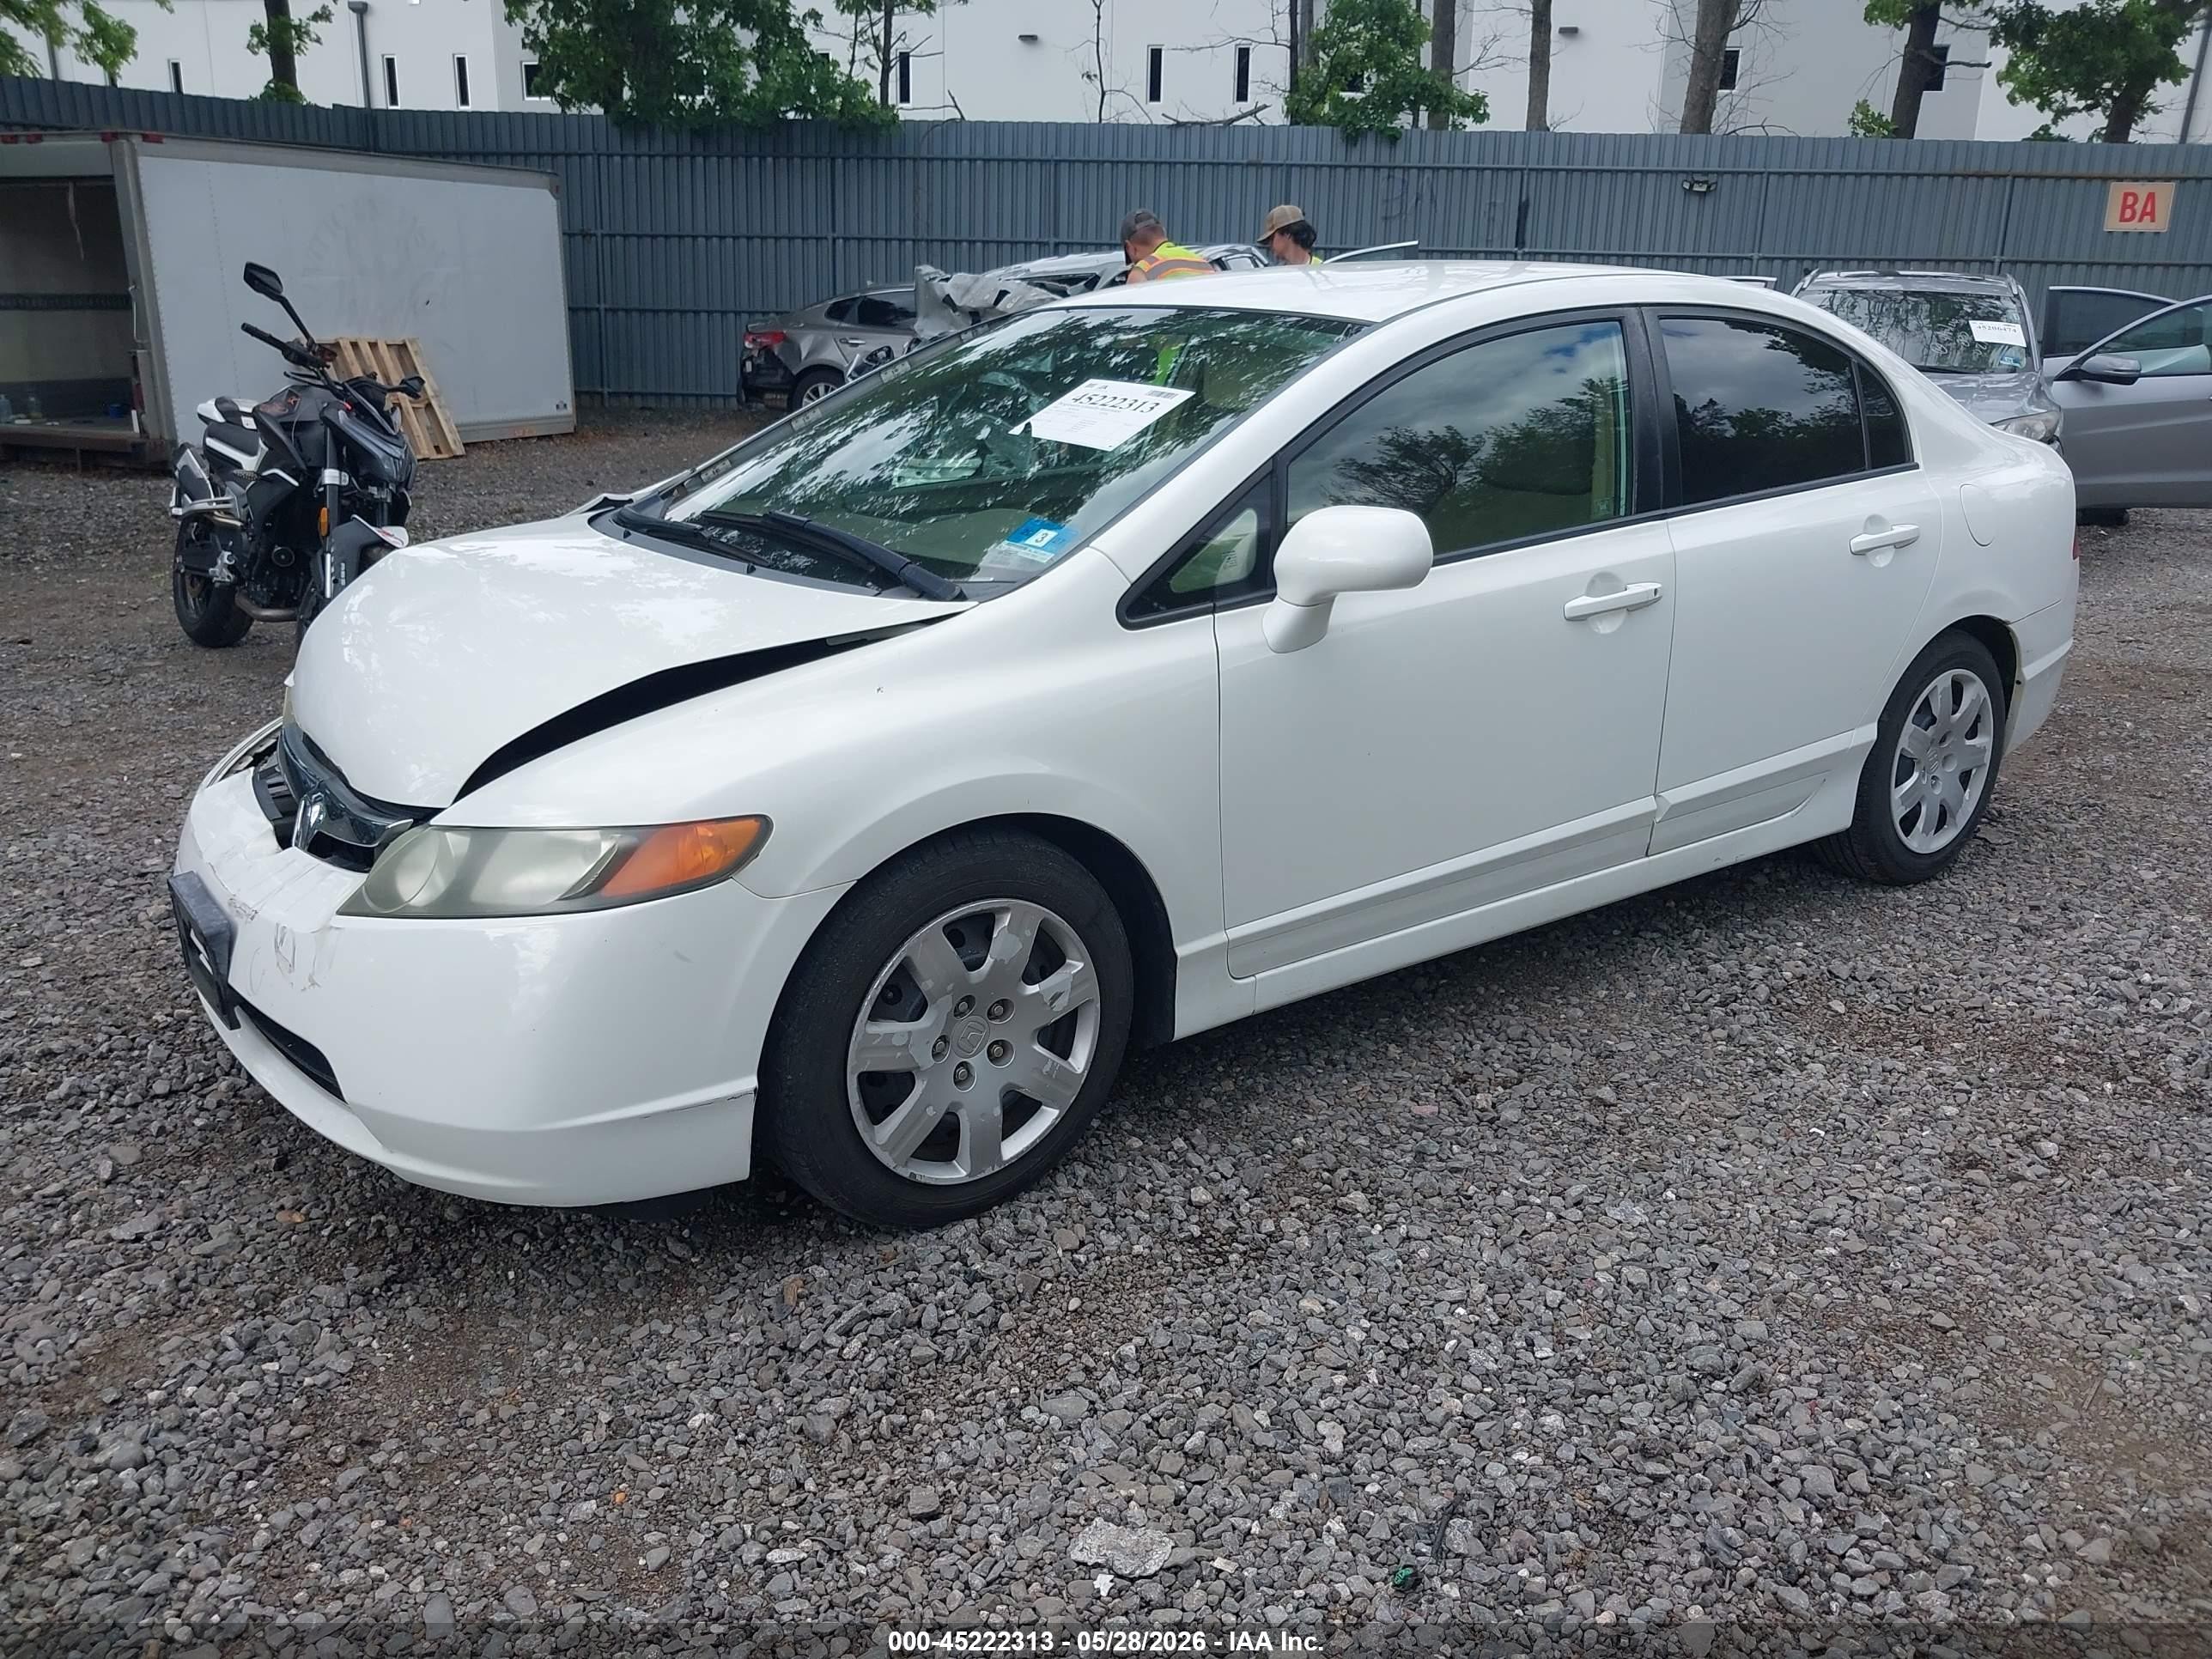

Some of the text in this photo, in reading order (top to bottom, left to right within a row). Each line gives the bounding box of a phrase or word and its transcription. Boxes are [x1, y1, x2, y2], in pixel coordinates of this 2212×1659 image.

[2118, 191, 2157, 223] BA
[1072, 392, 1161, 413] 45222313
[1035, 532, 1048, 544] 3
